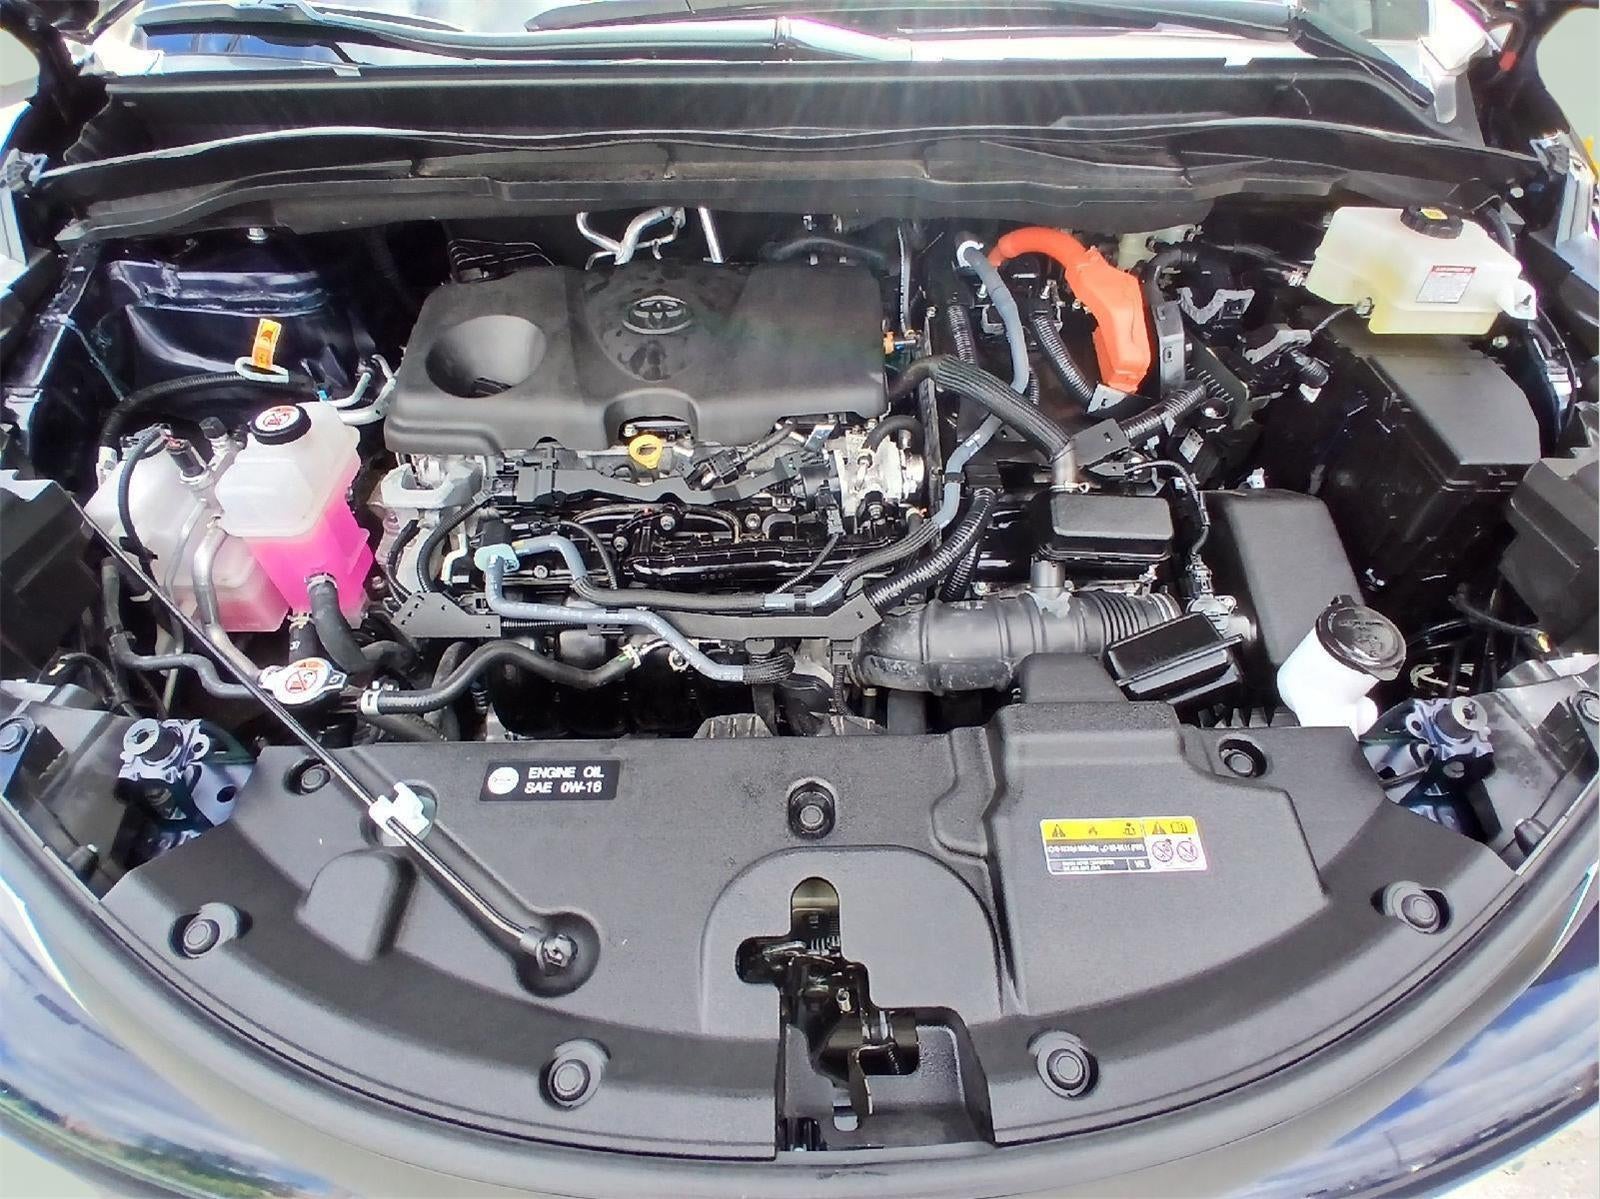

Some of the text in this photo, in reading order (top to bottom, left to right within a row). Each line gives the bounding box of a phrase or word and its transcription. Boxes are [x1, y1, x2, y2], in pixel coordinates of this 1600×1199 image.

[528, 766, 604, 778] ENGINE OIL
[524, 781, 602, 794] SAE 0W-16
